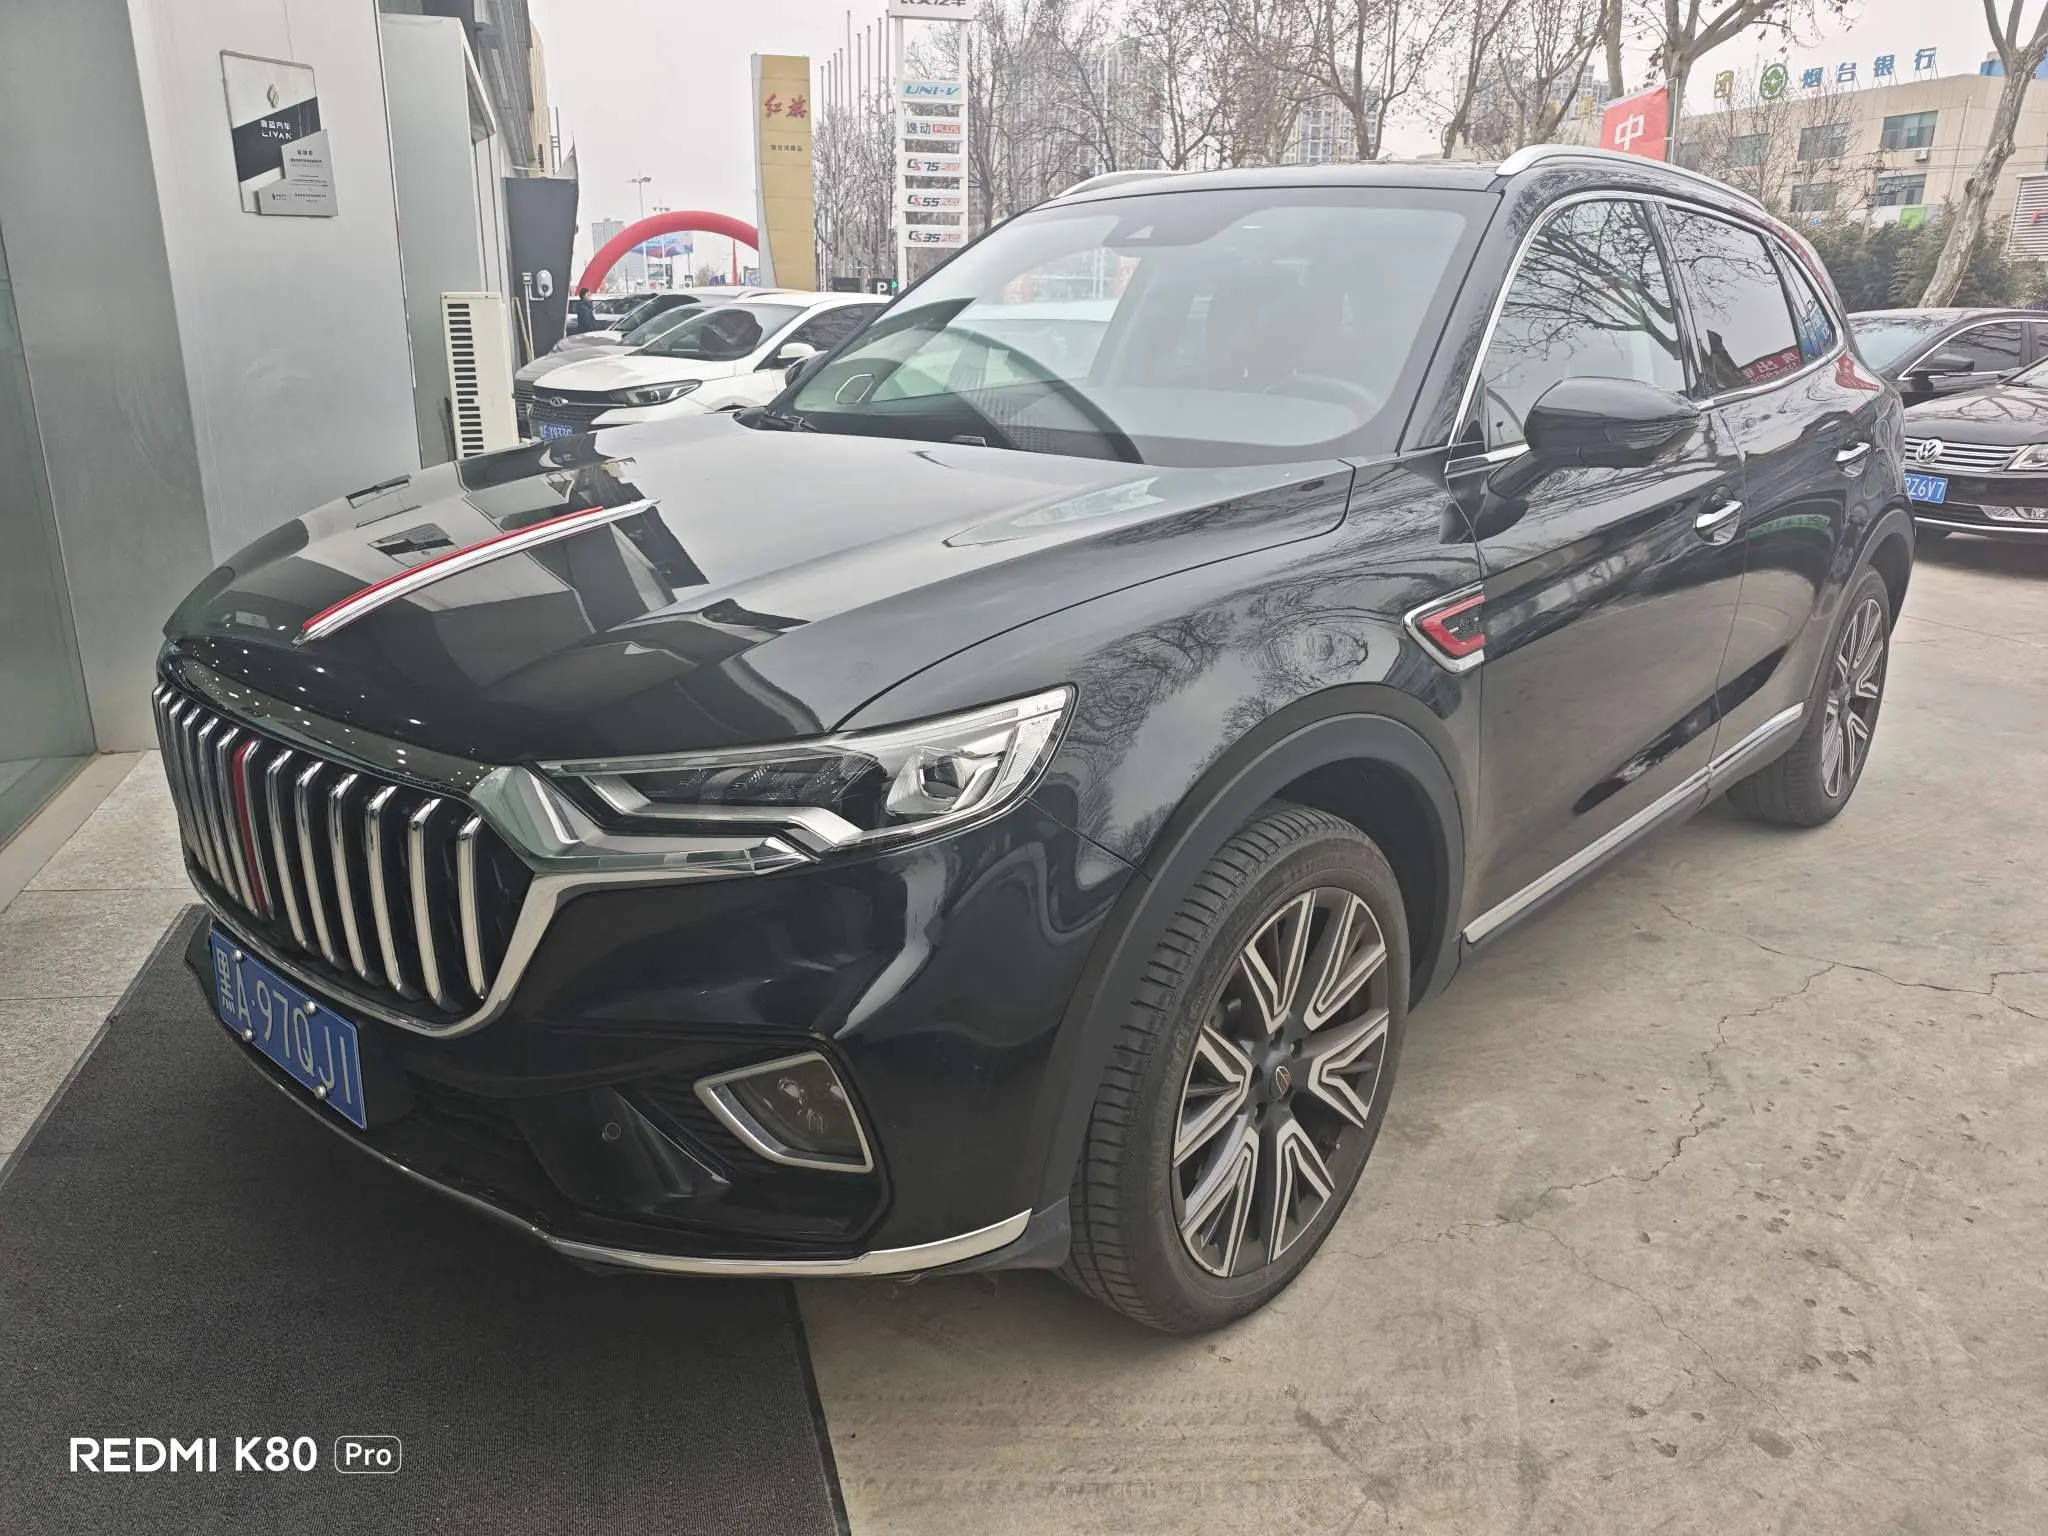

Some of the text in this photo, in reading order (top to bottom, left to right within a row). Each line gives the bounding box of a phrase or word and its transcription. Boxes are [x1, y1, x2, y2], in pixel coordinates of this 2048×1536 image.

[1801, 47, 1938, 89] 烟台银行
[904, 85, 960, 96] UNI-V
[764, 93, 808, 119] 红旗
[261, 129, 293, 140] LIVAN
[1614, 113, 1646, 152] 中
